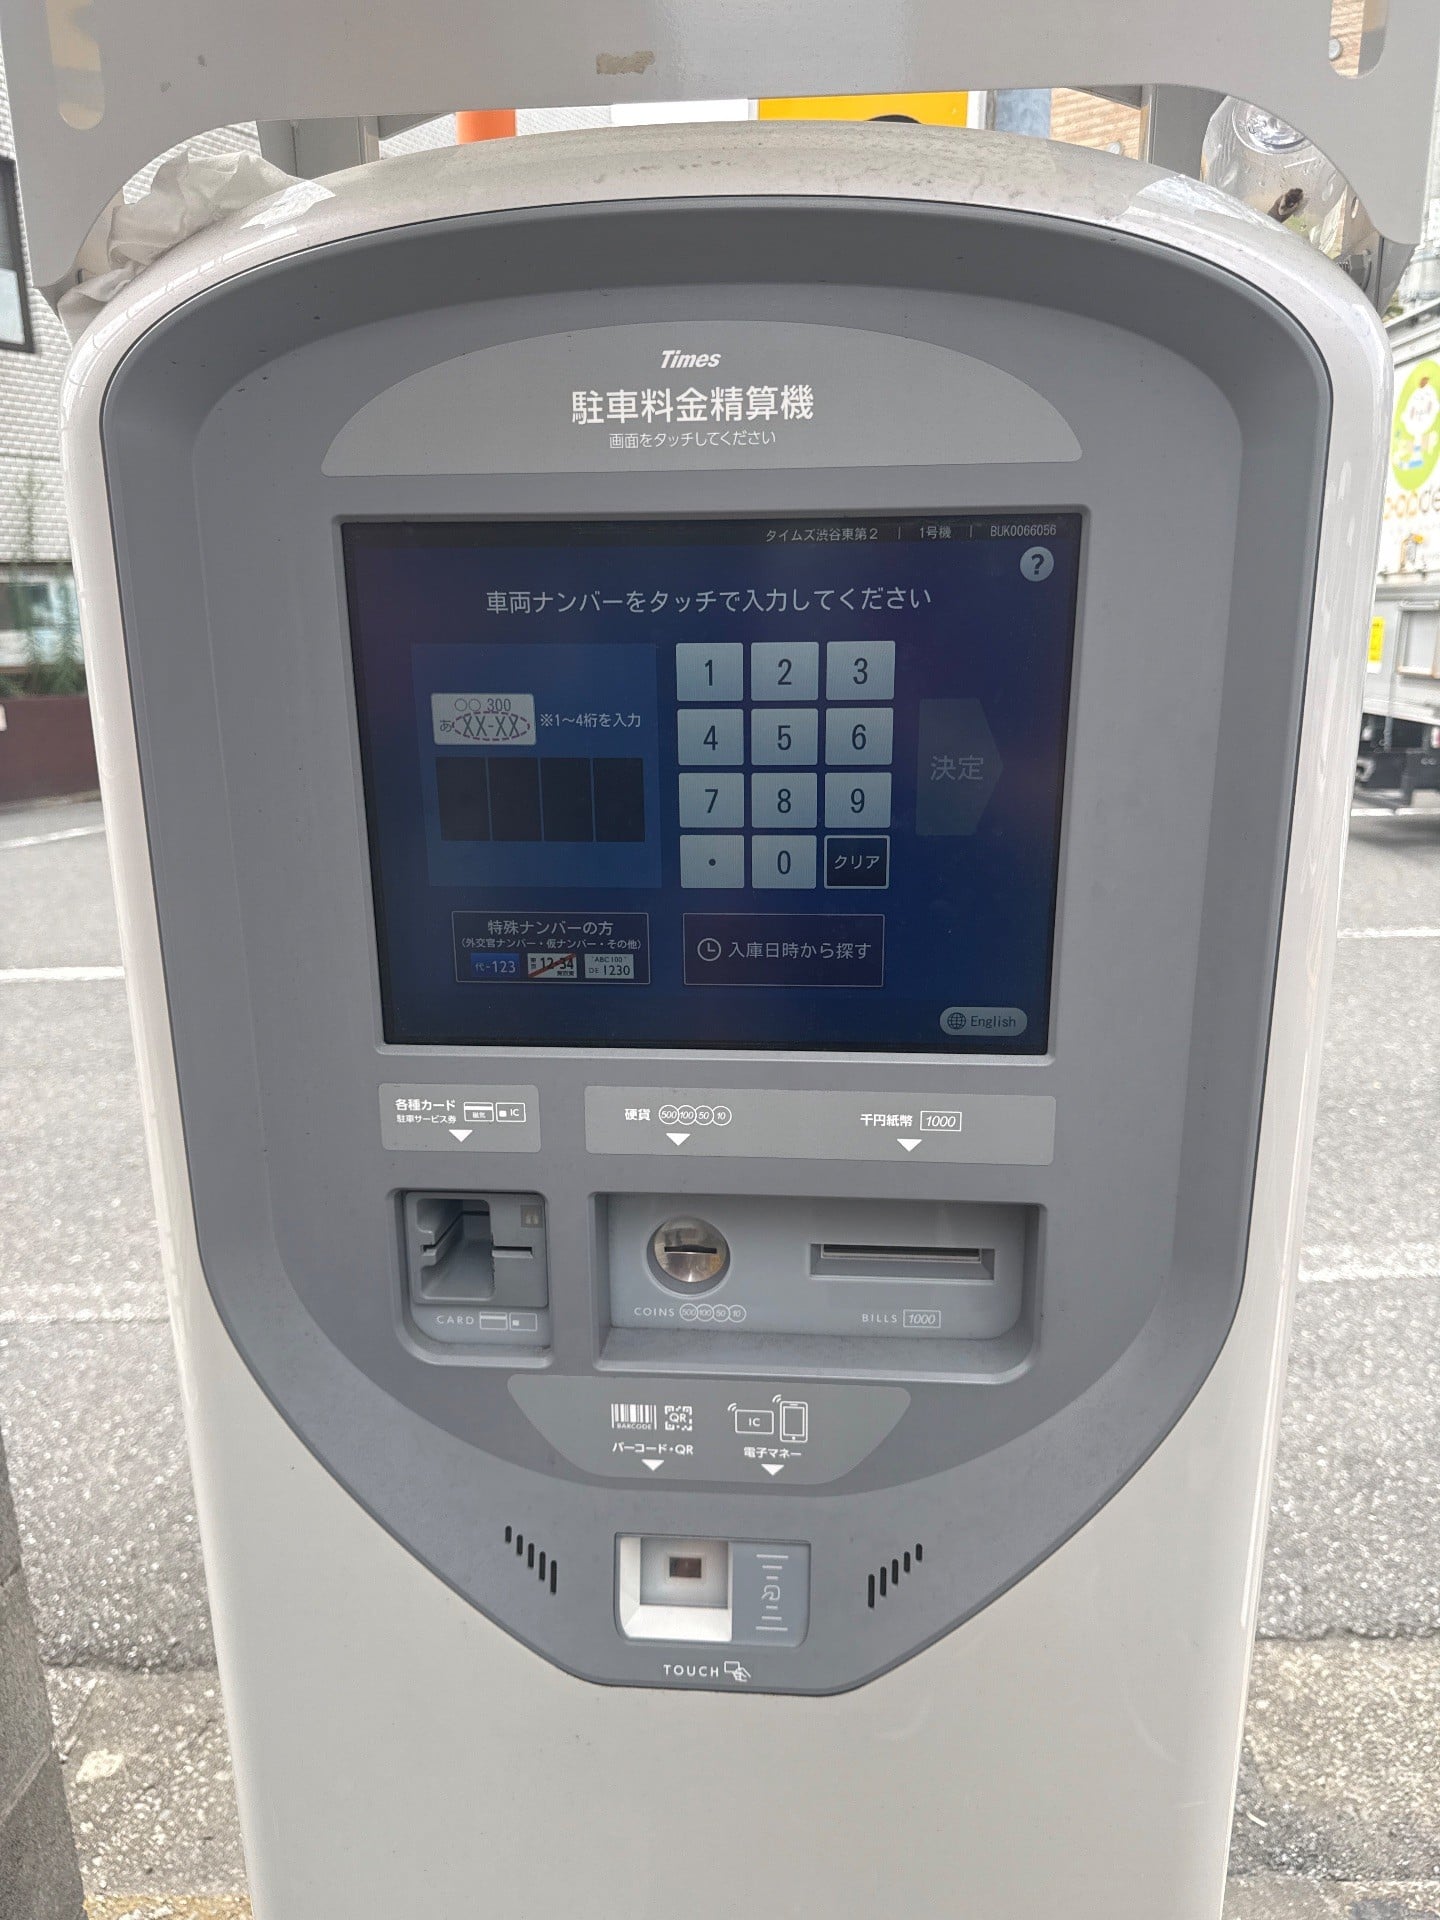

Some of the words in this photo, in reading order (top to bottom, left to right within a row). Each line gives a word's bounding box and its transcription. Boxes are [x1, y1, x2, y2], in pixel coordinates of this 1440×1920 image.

[660, 350, 721, 369] Times
[572, 384, 815, 425] 駐車料金精算機
[609, 430, 776, 449] 画面をタッチしてください
[919, 525, 952, 540] 1号機
[990, 524, 1057, 538] BUK0066056
[486, 587, 932, 614] 車両ナンバーをタッチで入力してください
[704, 659, 713, 687] 1
[777, 658, 792, 686] 2
[853, 657, 868, 685] 3
[487, 698, 511, 712] 300
[703, 725, 718, 750] 4
[777, 725, 792, 750] 5
[851, 724, 867, 750] 6
[930, 755, 984, 781] 決定
[704, 788, 719, 814] 7
[777, 788, 792, 814] 8
[850, 788, 865, 814] 9
[777, 850, 791, 875] 0
[834, 854, 880, 870] クリア
[487, 919, 614, 936] 特殊ナンバーの方
[728, 941, 871, 960] 入庫日時から探す
[603, 965, 631, 976] 1230
[970, 1015, 1016, 1029] English
[395, 1098, 456, 1111] 各種カード
[396, 1114, 457, 1124] 駐車サービス券
[510, 1108, 520, 1117] IC
[624, 1108, 651, 1121] 硬貨
[661, 1109, 677, 1120] 500
[679, 1109, 694, 1120] 100
[698, 1111, 710, 1120] 50
[717, 1111, 726, 1120] 10
[860, 1113, 913, 1127] 千円紙幣
[926, 1115, 956, 1128] 1000
[634, 1307, 675, 1317] COINS
[862, 1313, 898, 1323] BILLS
[908, 1313, 936, 1325] 1000
[436, 1315, 474, 1325] CARD
[669, 1413, 687, 1424] QR
[748, 1417, 761, 1427] IC
[612, 1442, 694, 1456] バーコード・QR
[743, 1446, 802, 1459] 電子マネー
[663, 1664, 719, 1677] TOUCH
